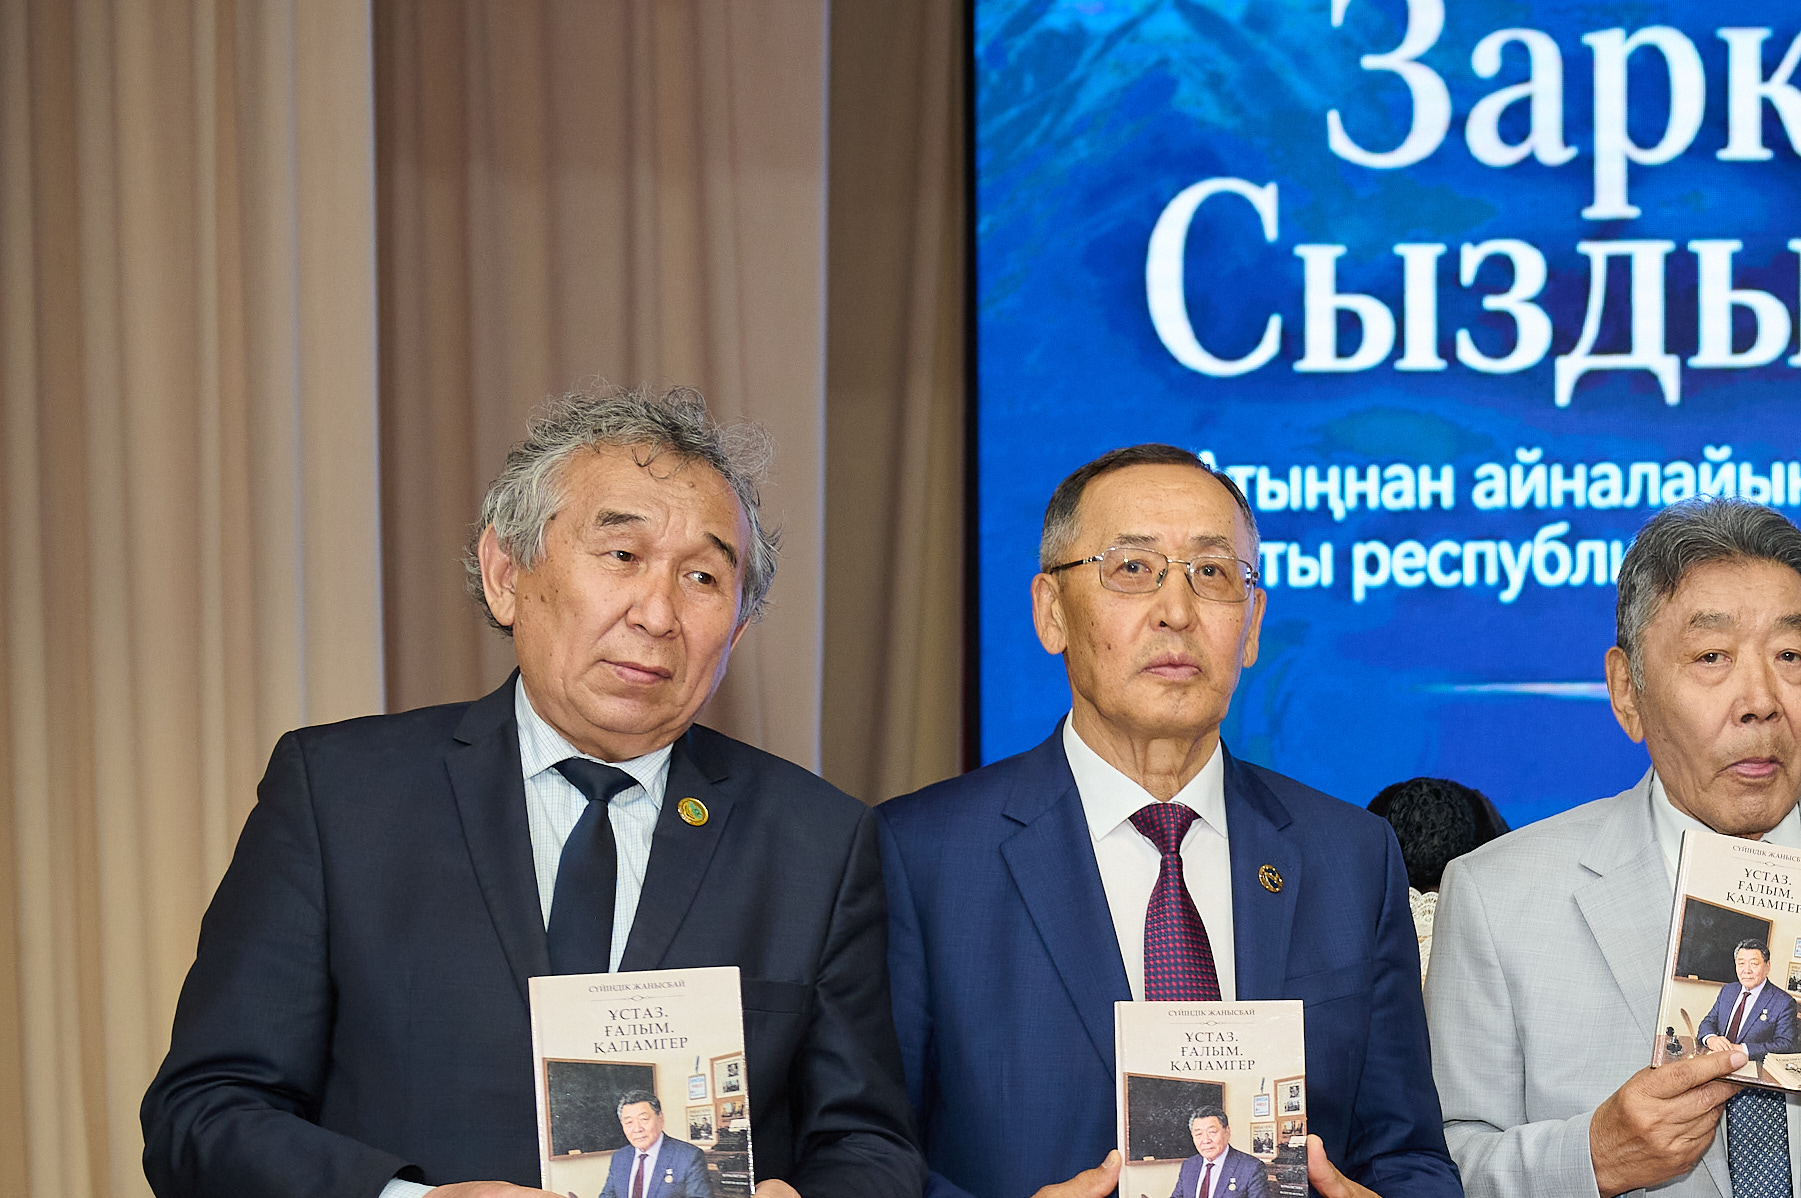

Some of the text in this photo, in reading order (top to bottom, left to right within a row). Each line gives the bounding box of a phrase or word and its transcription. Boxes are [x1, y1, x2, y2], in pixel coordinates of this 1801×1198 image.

[1743, 867, 1793, 887] ҰСТАЗ.
[1737, 880, 1795, 900] ҒАЛЫМ.
[608, 1006, 669, 1021] ҰСТАЗ.
[604, 1022, 675, 1037] ҒАЛЫМ.
[1184, 1031, 1239, 1043] ҰСТАЗ.
[594, 1037, 689, 1054] ҚАЛАМГЕР
[1180, 1045, 1244, 1057] ҒАЛЫМ.
[1170, 1059, 1256, 1073] ҚАЛАМГЕР
